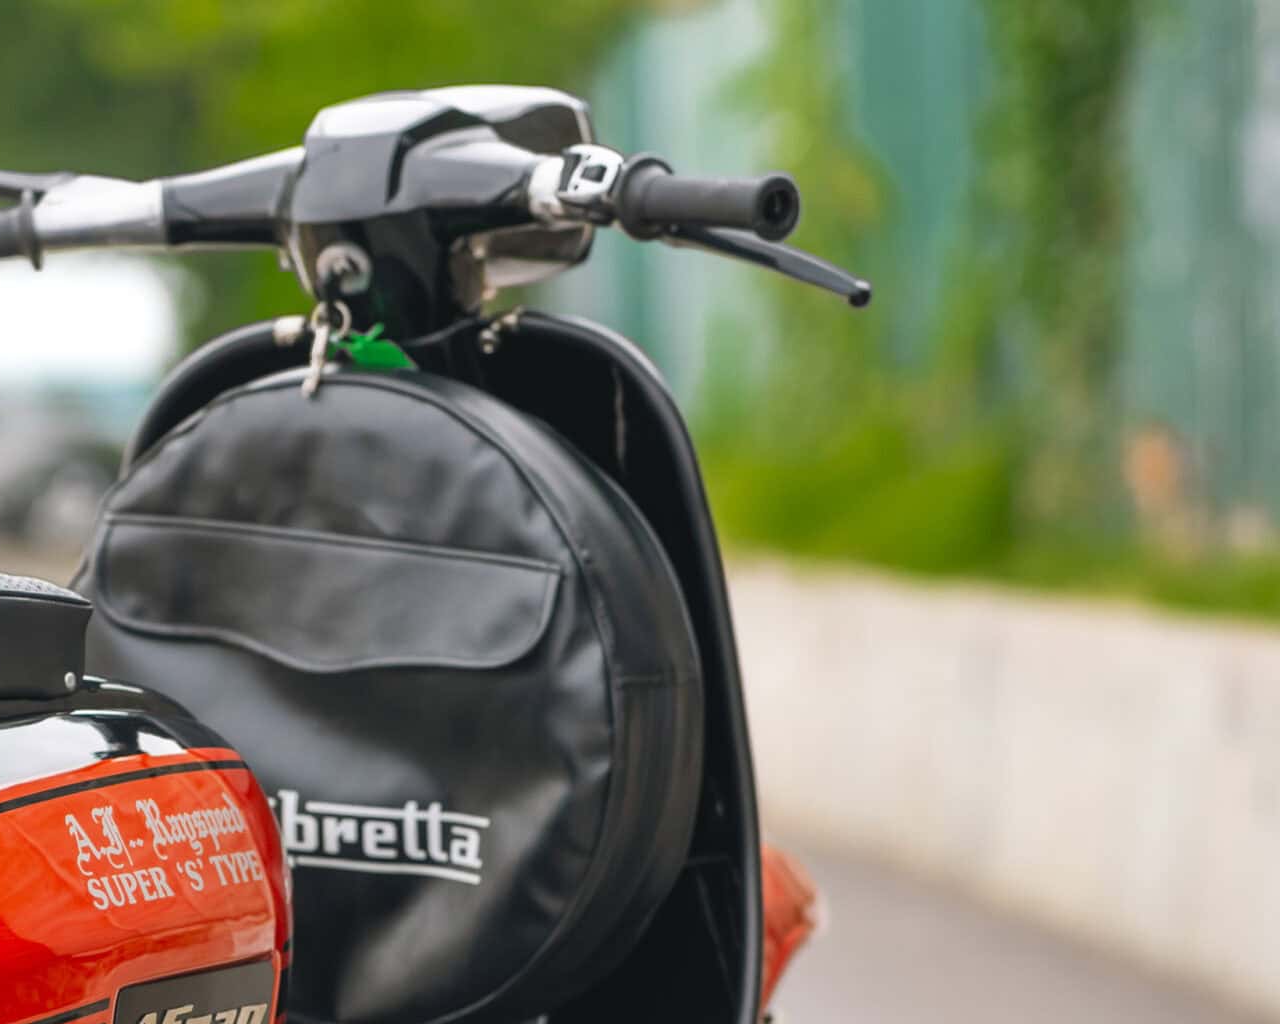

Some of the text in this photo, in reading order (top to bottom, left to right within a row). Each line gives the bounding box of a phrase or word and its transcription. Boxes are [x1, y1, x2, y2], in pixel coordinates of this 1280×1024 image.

[277, 789, 483, 869] bretta
[88, 867, 175, 911] SUPER
[209, 850, 264, 887] TYPE
